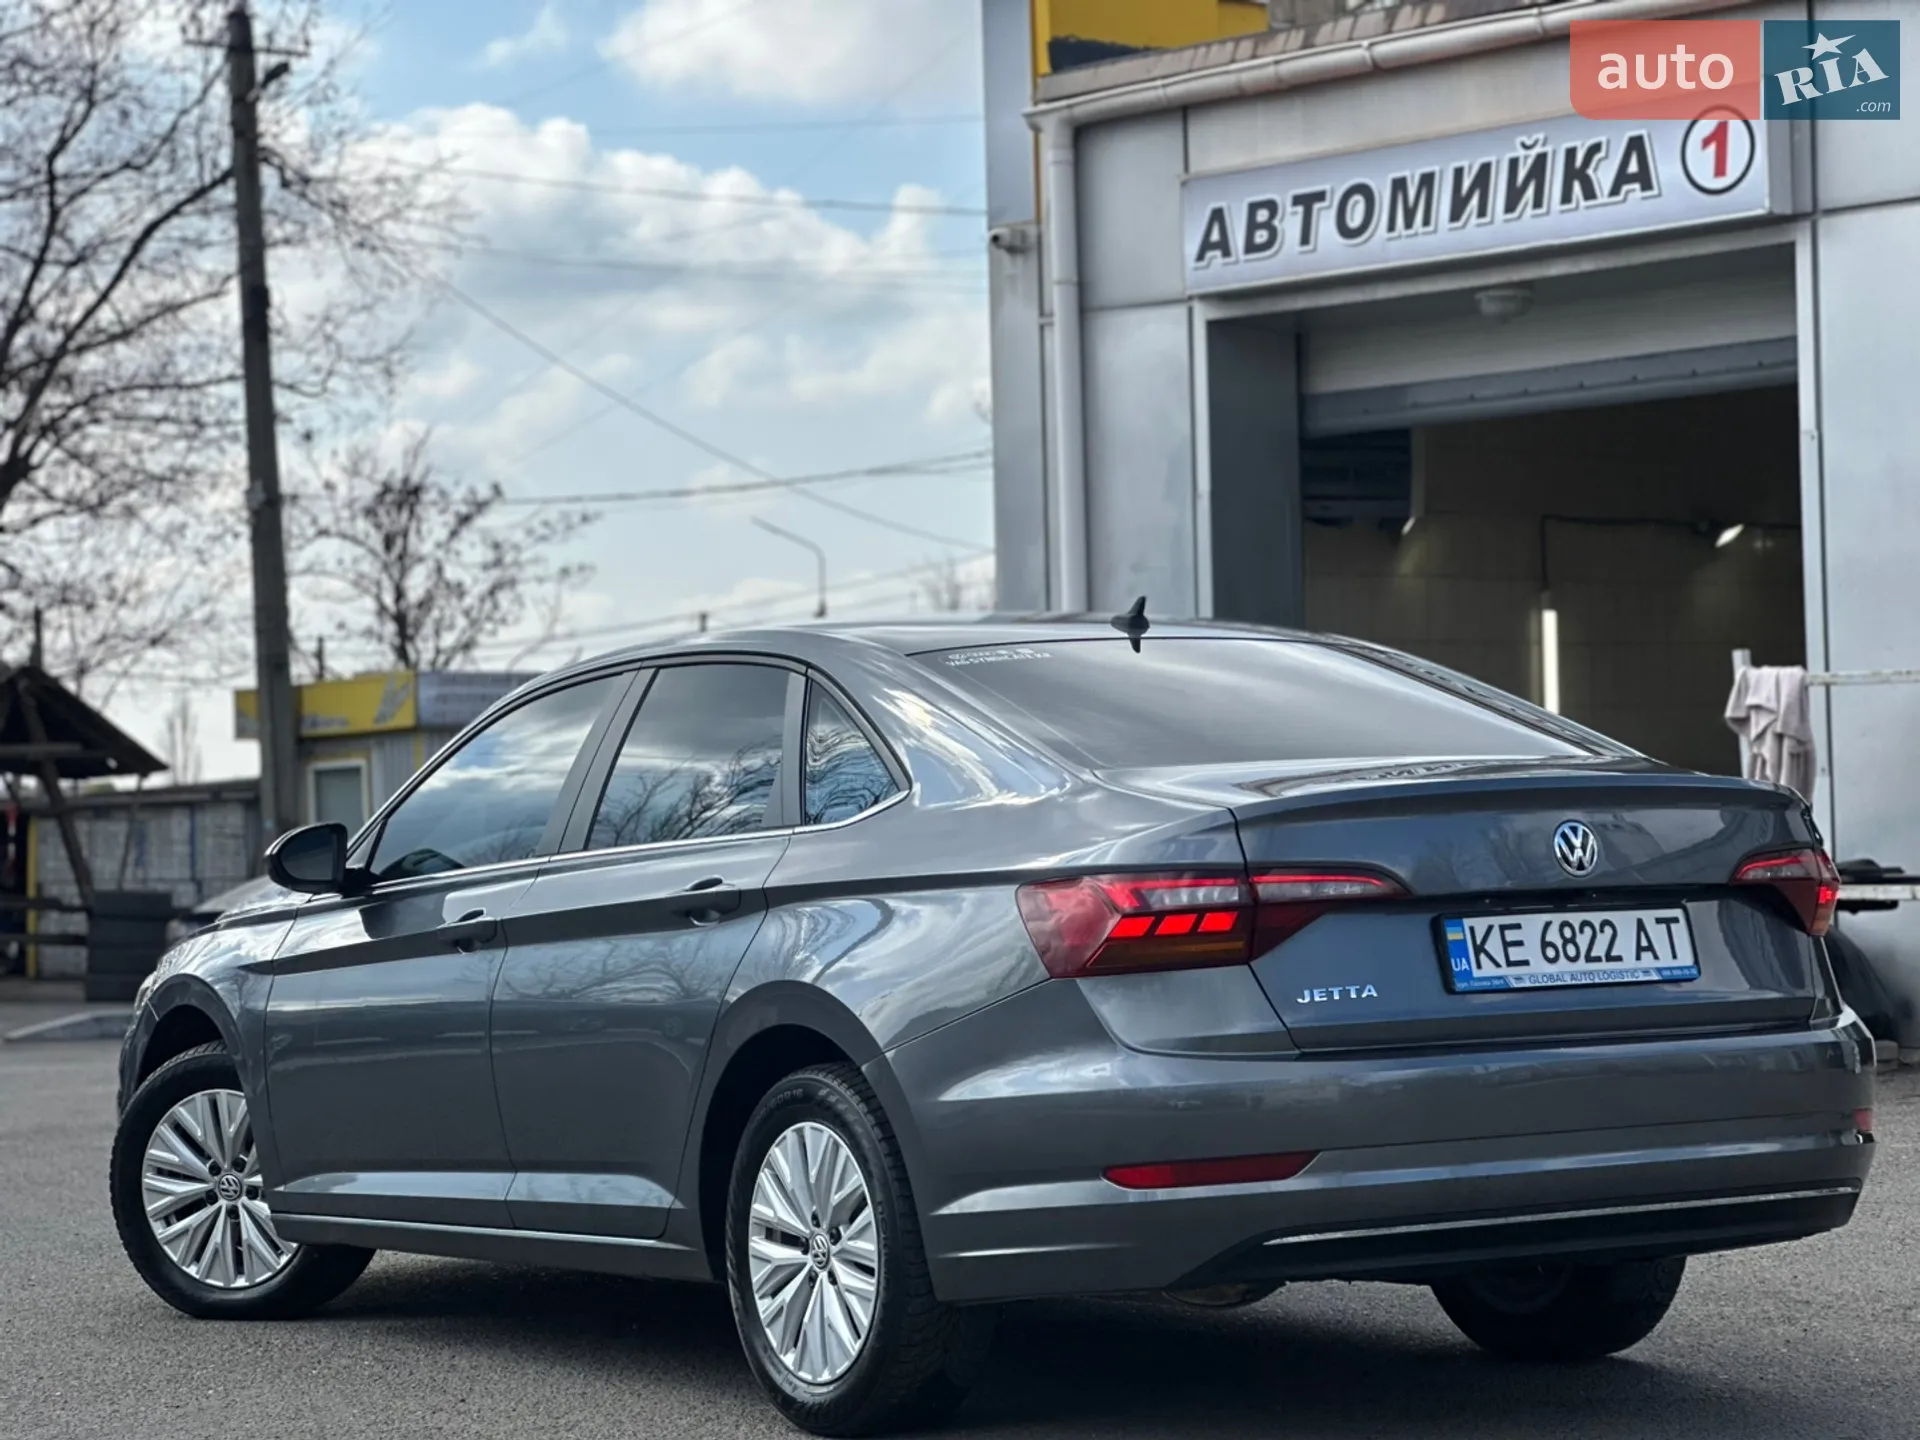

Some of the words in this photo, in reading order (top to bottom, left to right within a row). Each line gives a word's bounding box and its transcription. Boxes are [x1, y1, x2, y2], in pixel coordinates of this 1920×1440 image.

[1194, 133, 1656, 264] АВТОМИЙКА
[1700, 120, 1730, 179] 1
[1469, 922, 1531, 970] KE
[1540, 918, 1623, 964] 6822
[1635, 916, 1680, 961] AT
[1451, 957, 1470, 972] UA
[1529, 973, 1567, 985] GLOBAL
[1569, 971, 1596, 983] AUTO
[1597, 969, 1641, 981] LOGISTIC
[1296, 983, 1379, 1004] JETTA
